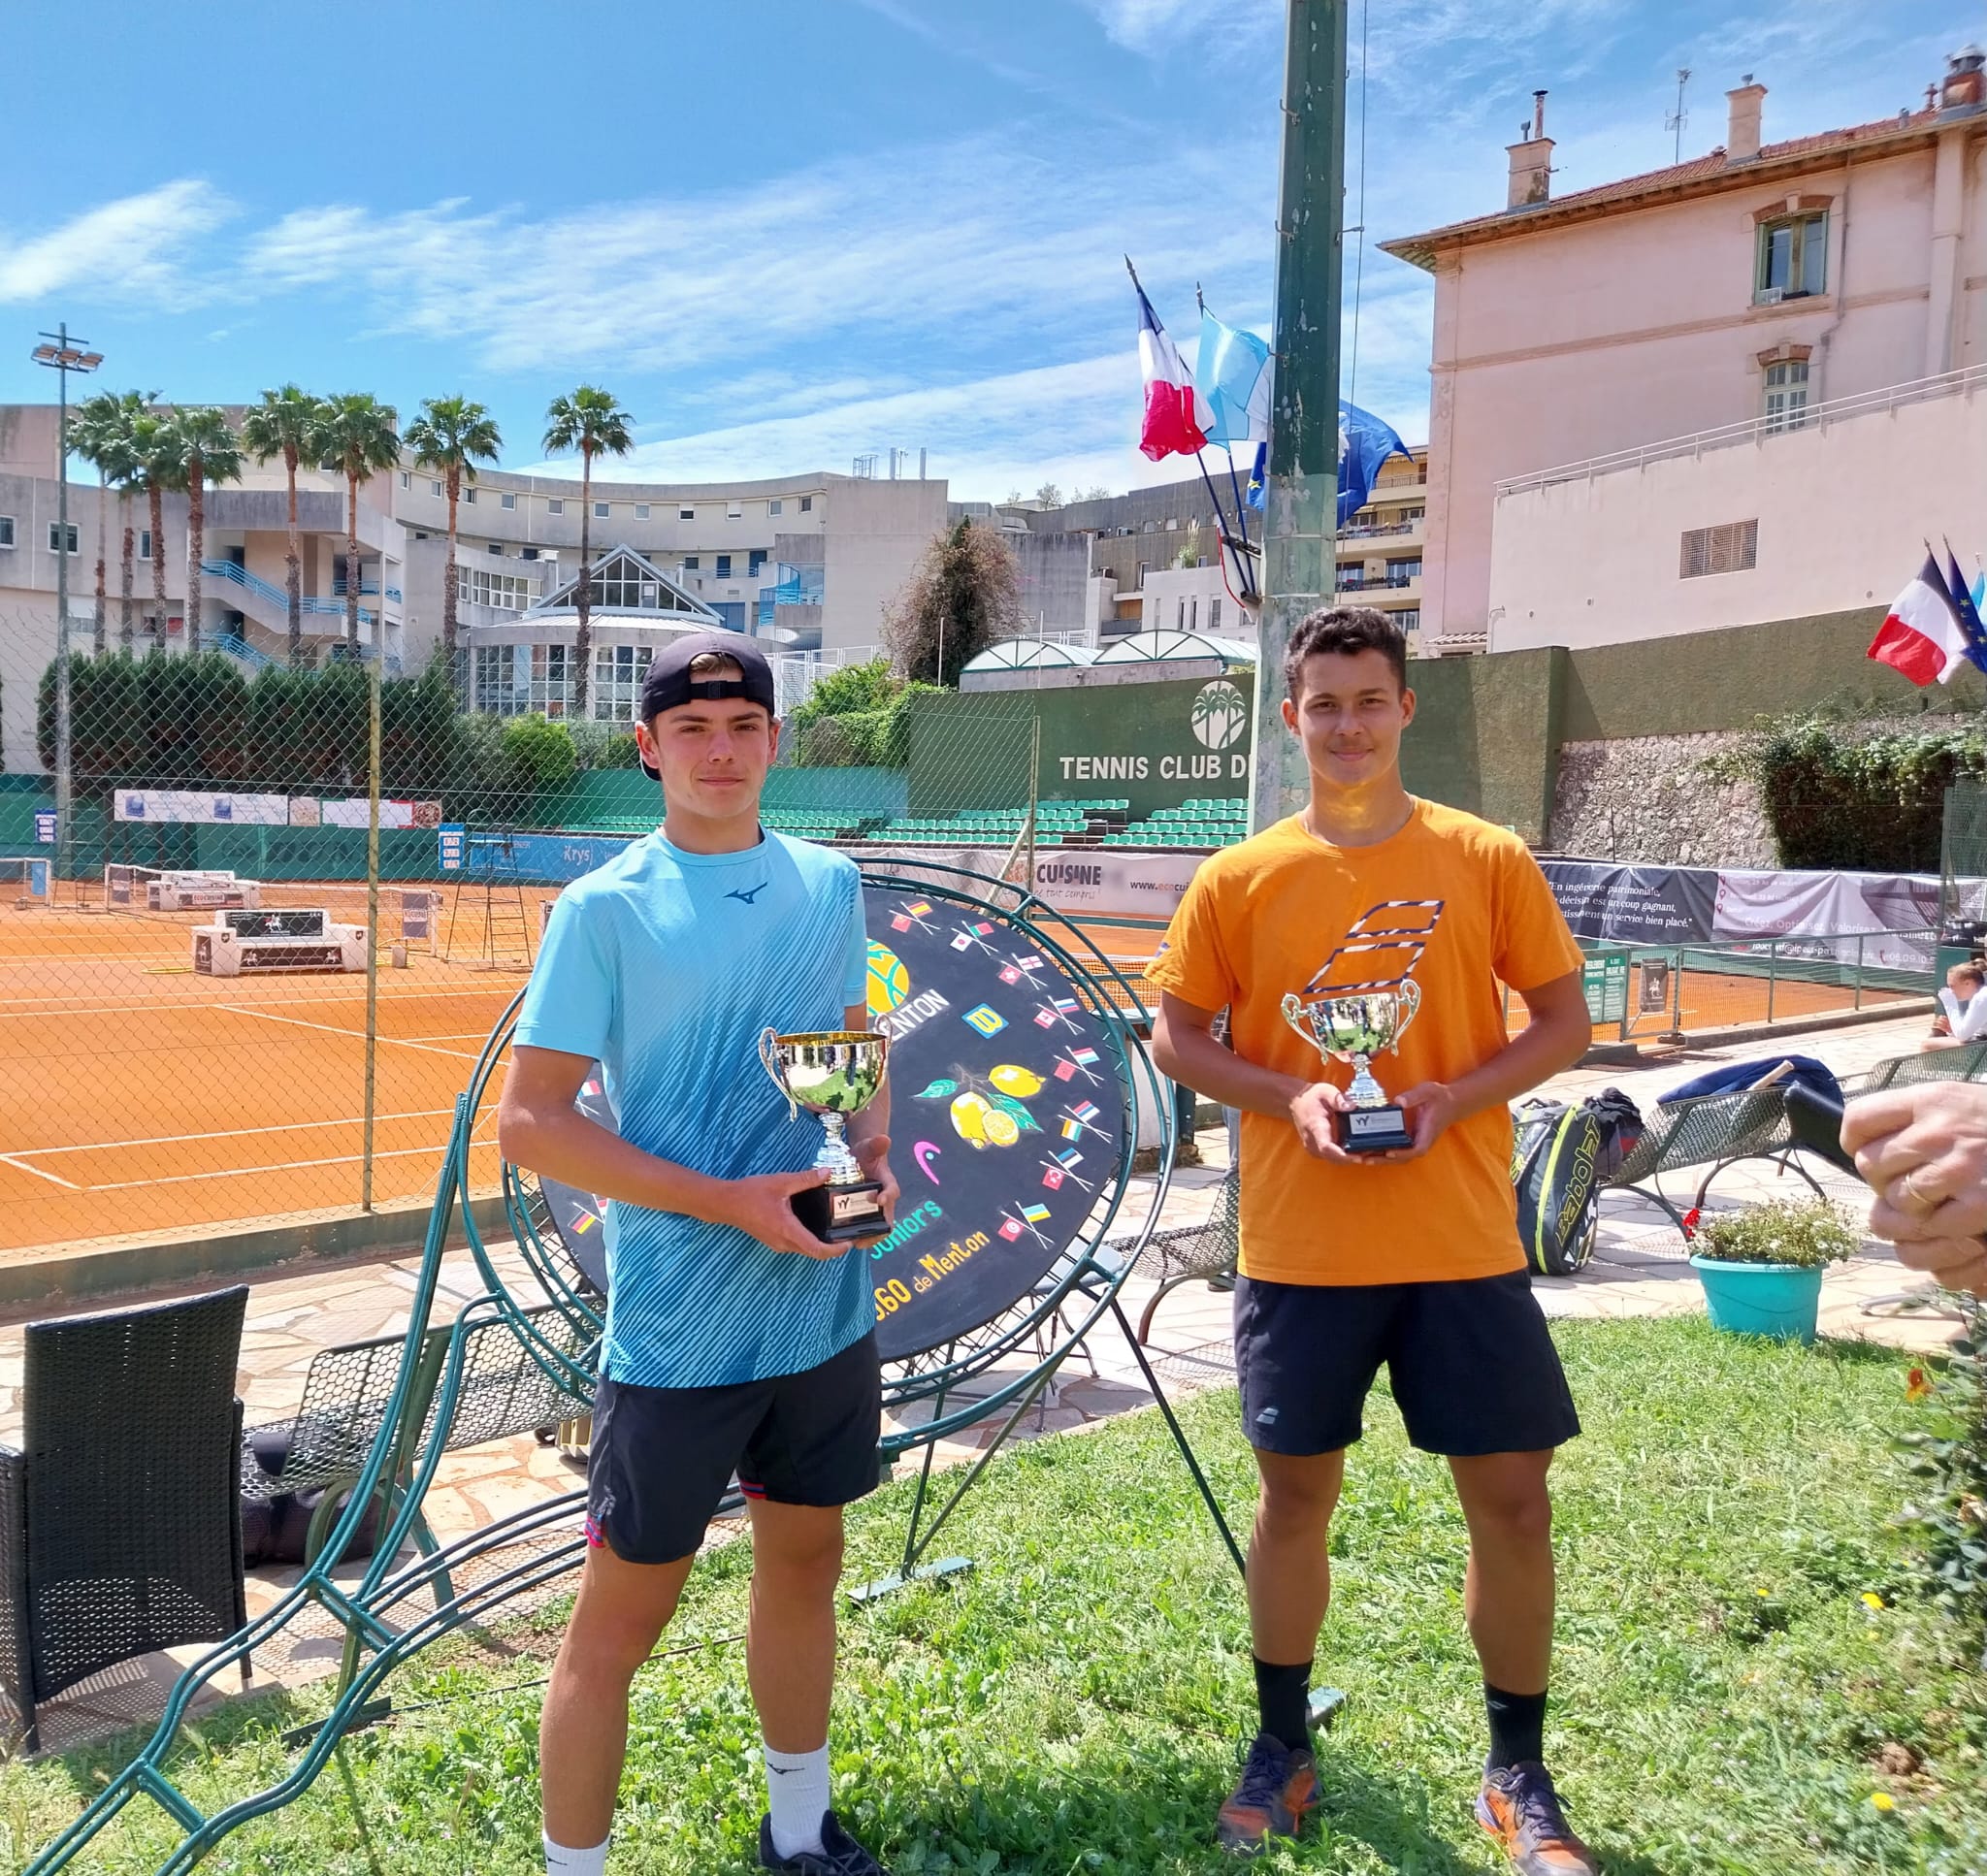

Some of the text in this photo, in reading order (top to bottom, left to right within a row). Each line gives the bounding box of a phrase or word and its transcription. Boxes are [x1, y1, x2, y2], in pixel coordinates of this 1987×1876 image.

[1059, 754, 1250, 780] TENNIS CLUB D
[1036, 863, 1101, 885] CUISINE
[1608, 898, 1619, 907] un
[1620, 901, 1640, 911] coup
[1645, 915, 1664, 925] bien
[919, 1231, 991, 1280] Menton
[913, 1276, 932, 1293] de
